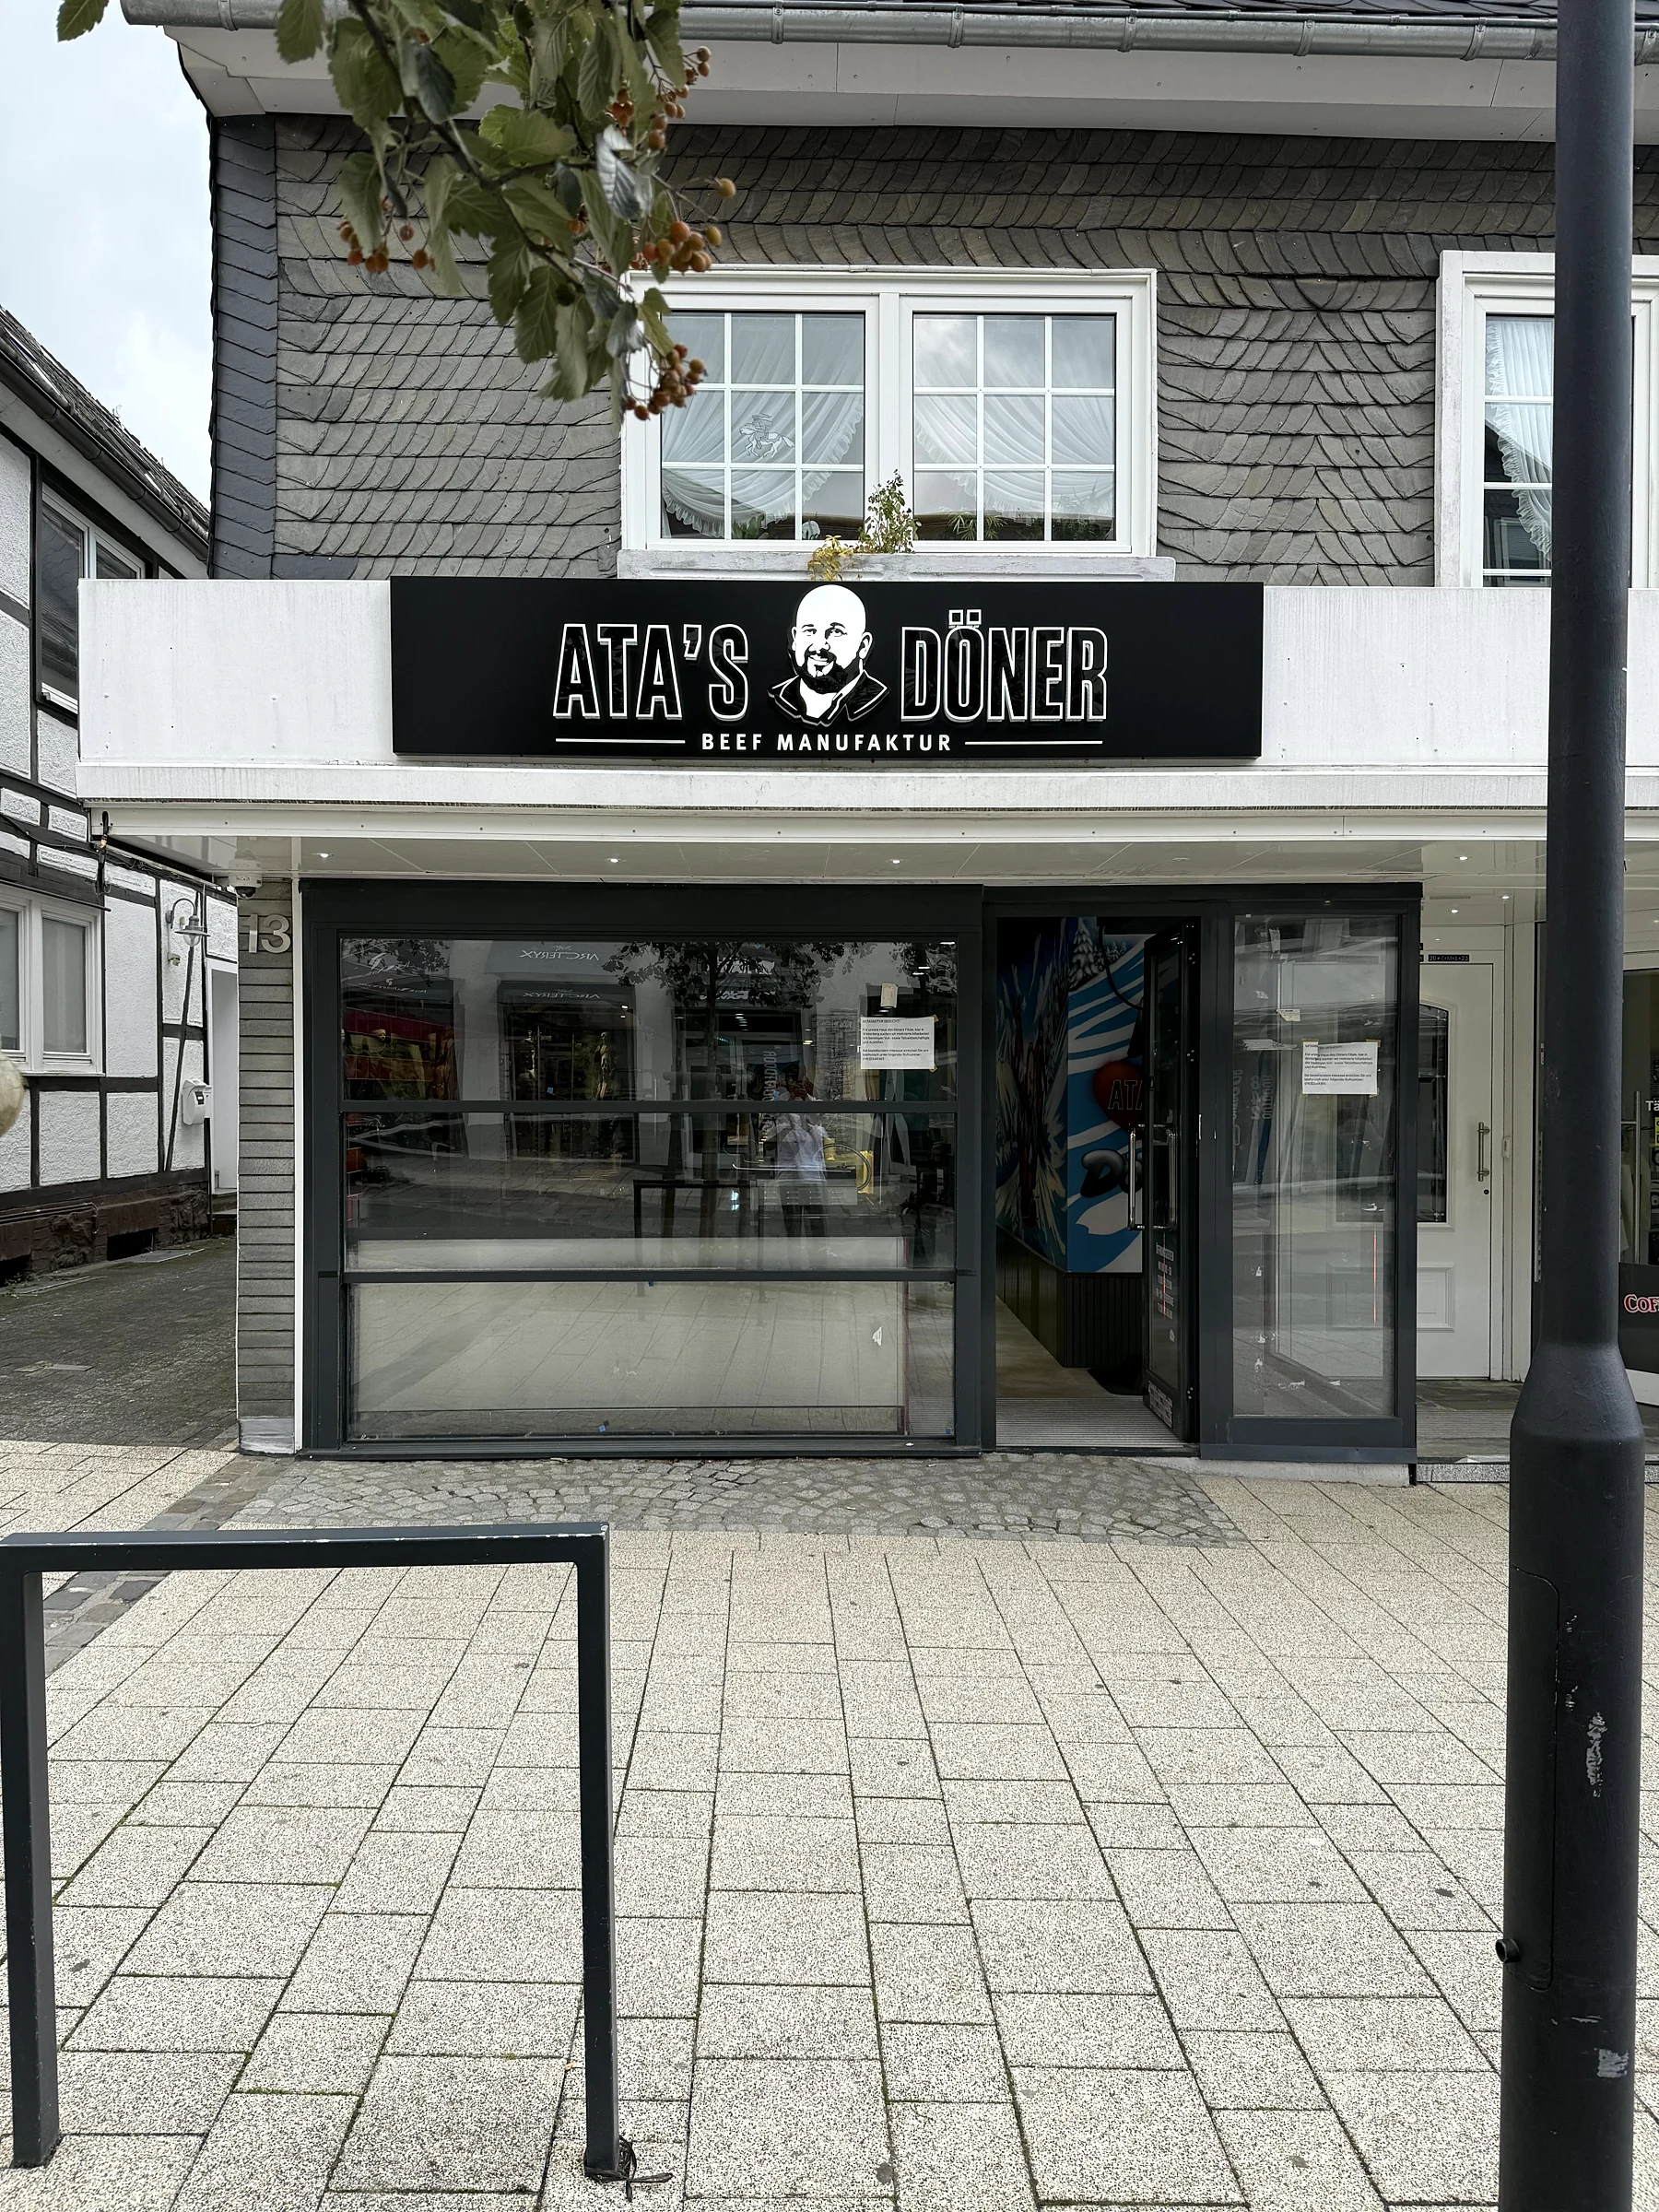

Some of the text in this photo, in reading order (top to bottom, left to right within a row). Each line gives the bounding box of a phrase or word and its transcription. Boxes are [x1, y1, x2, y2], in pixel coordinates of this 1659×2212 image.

[553, 608, 1108, 723] ATA'S DÖNER
[701, 733, 951, 751] BEEF MANUFAKTUR
[240, 913, 291, 953] 13
